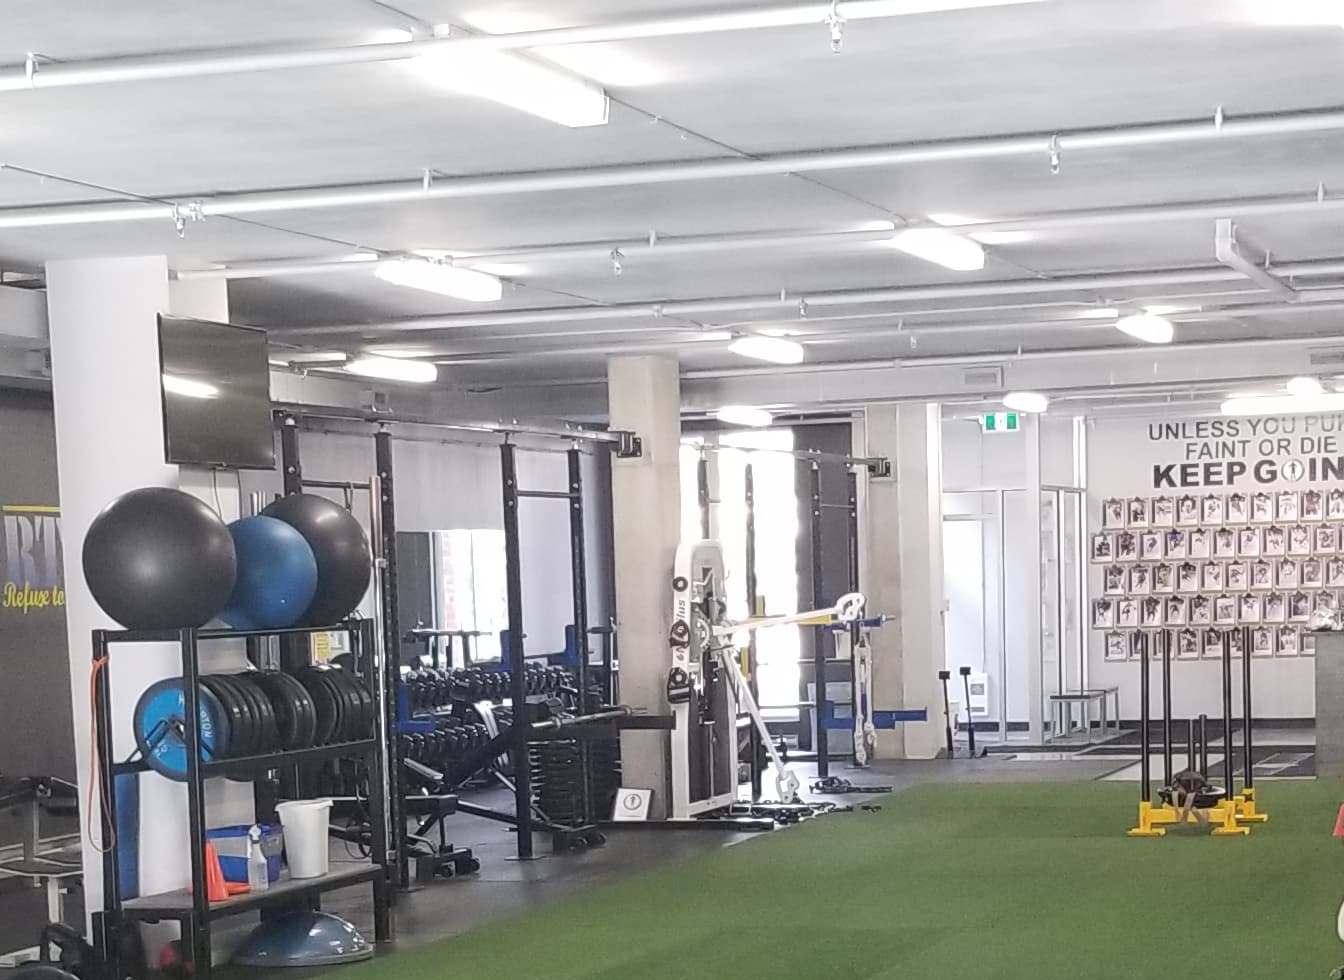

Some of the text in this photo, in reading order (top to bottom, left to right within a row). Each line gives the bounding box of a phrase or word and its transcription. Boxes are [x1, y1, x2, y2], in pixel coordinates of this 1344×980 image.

[1148, 419, 1240, 441] UNLESS
[1248, 416, 1296, 436] YOU
[1185, 436, 1338, 460] FAINT OR DIE
[1153, 461, 1247, 488] KEEP
[2, 581, 65, 615] Refuse to
